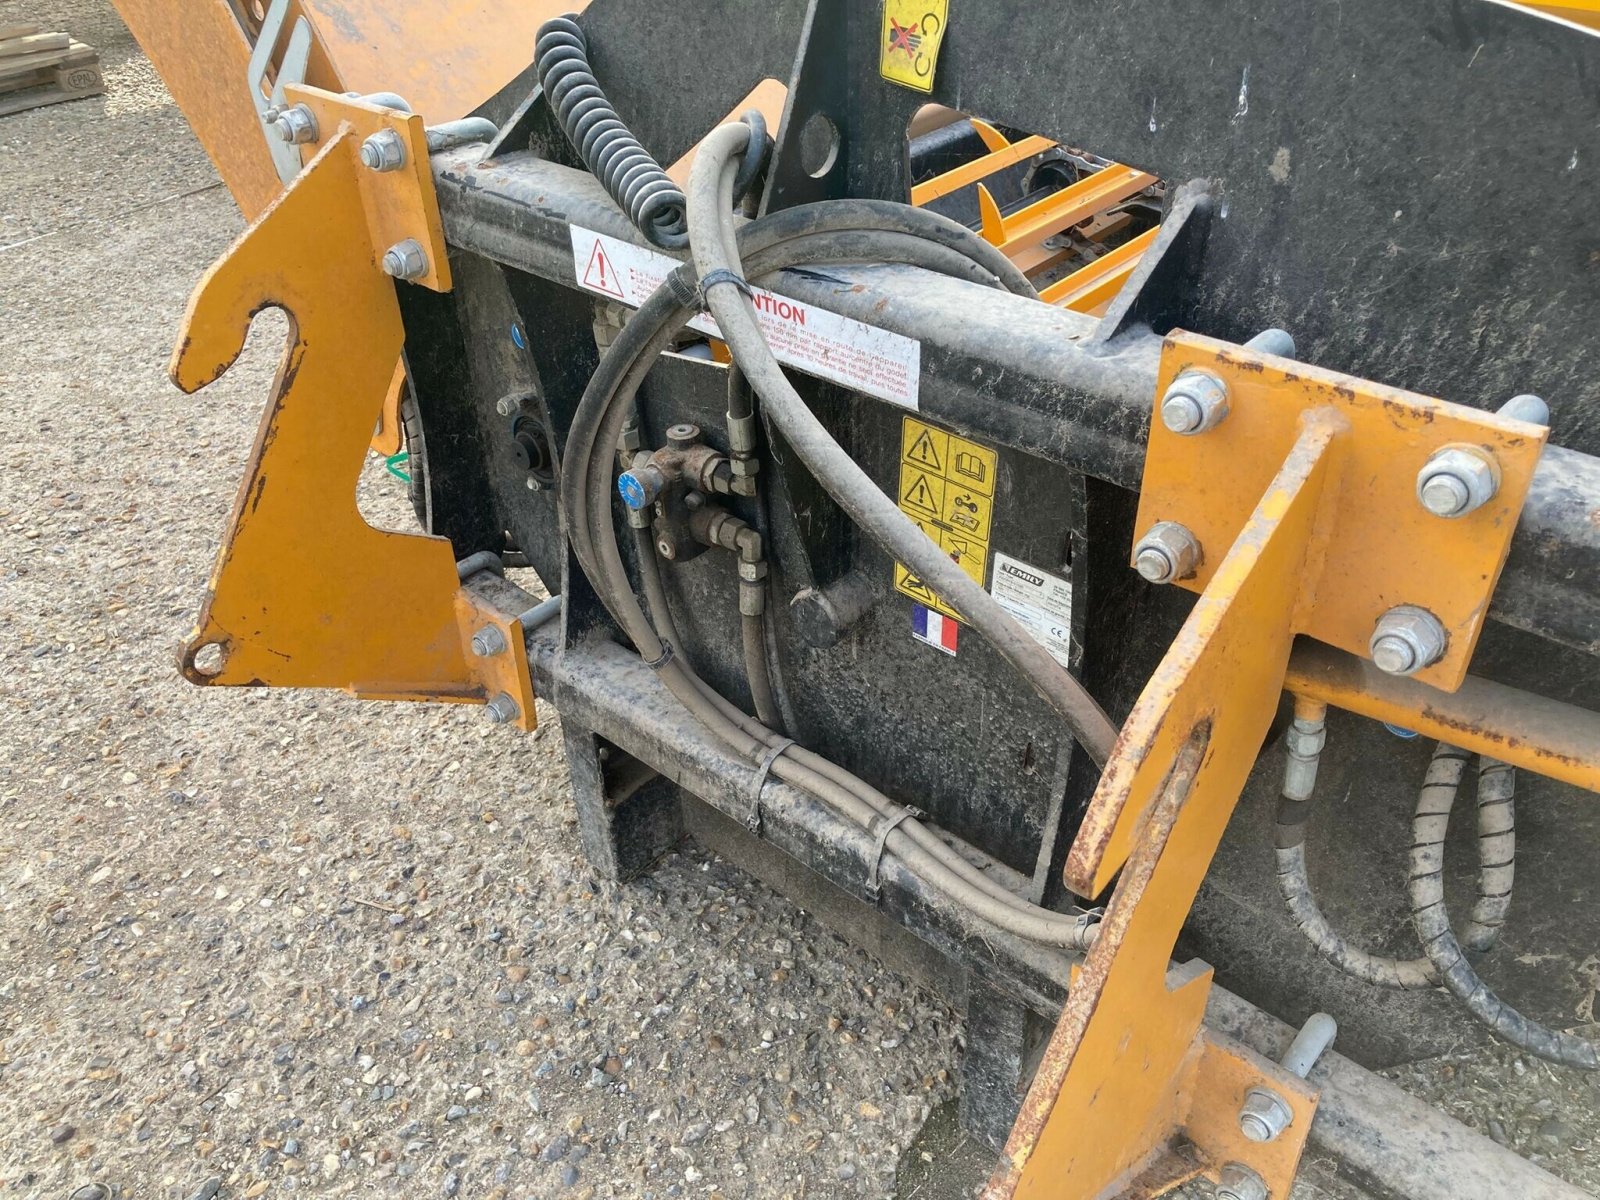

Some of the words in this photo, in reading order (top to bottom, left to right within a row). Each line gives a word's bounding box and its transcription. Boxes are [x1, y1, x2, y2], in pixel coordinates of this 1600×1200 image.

[753, 294, 805, 325] NTION
[800, 329, 818, 339] mise
[833, 340, 853, 352] route
[856, 347, 866, 356] de
[886, 367, 907, 379] godet
[887, 383, 908, 397] toutes
[1009, 568, 1042, 586] EMILY
